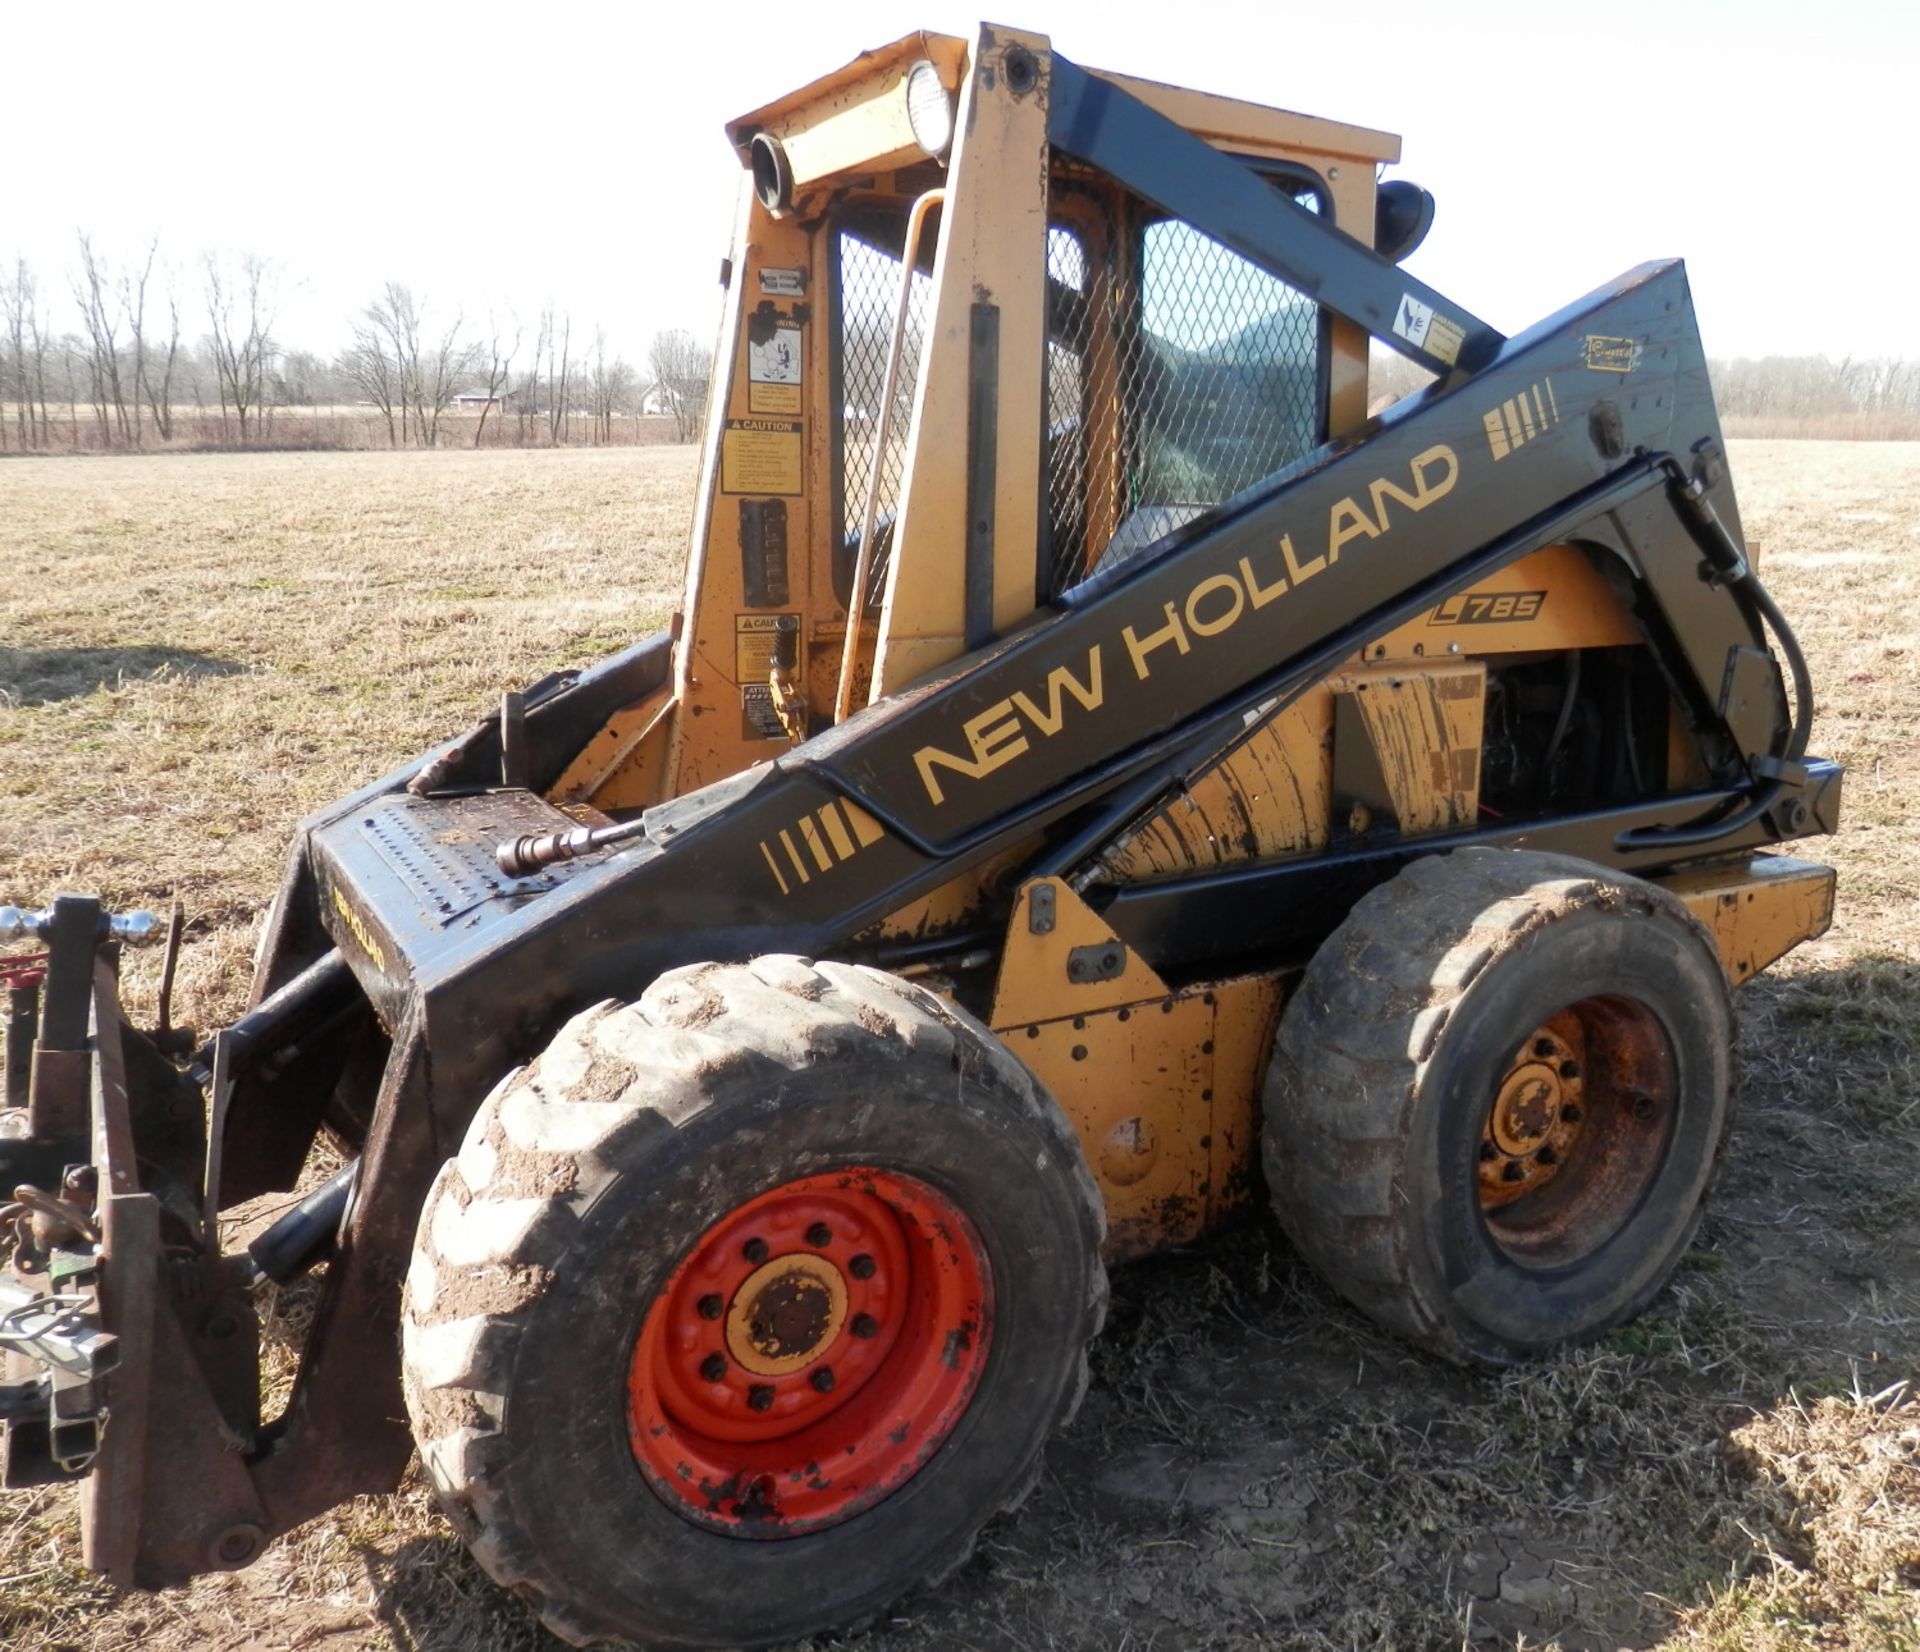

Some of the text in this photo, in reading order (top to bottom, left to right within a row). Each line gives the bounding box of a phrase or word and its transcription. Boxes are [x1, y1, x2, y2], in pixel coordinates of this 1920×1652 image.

[744, 421, 792, 431] CAUTION
[912, 444, 1459, 806] NEW HOLLAND
